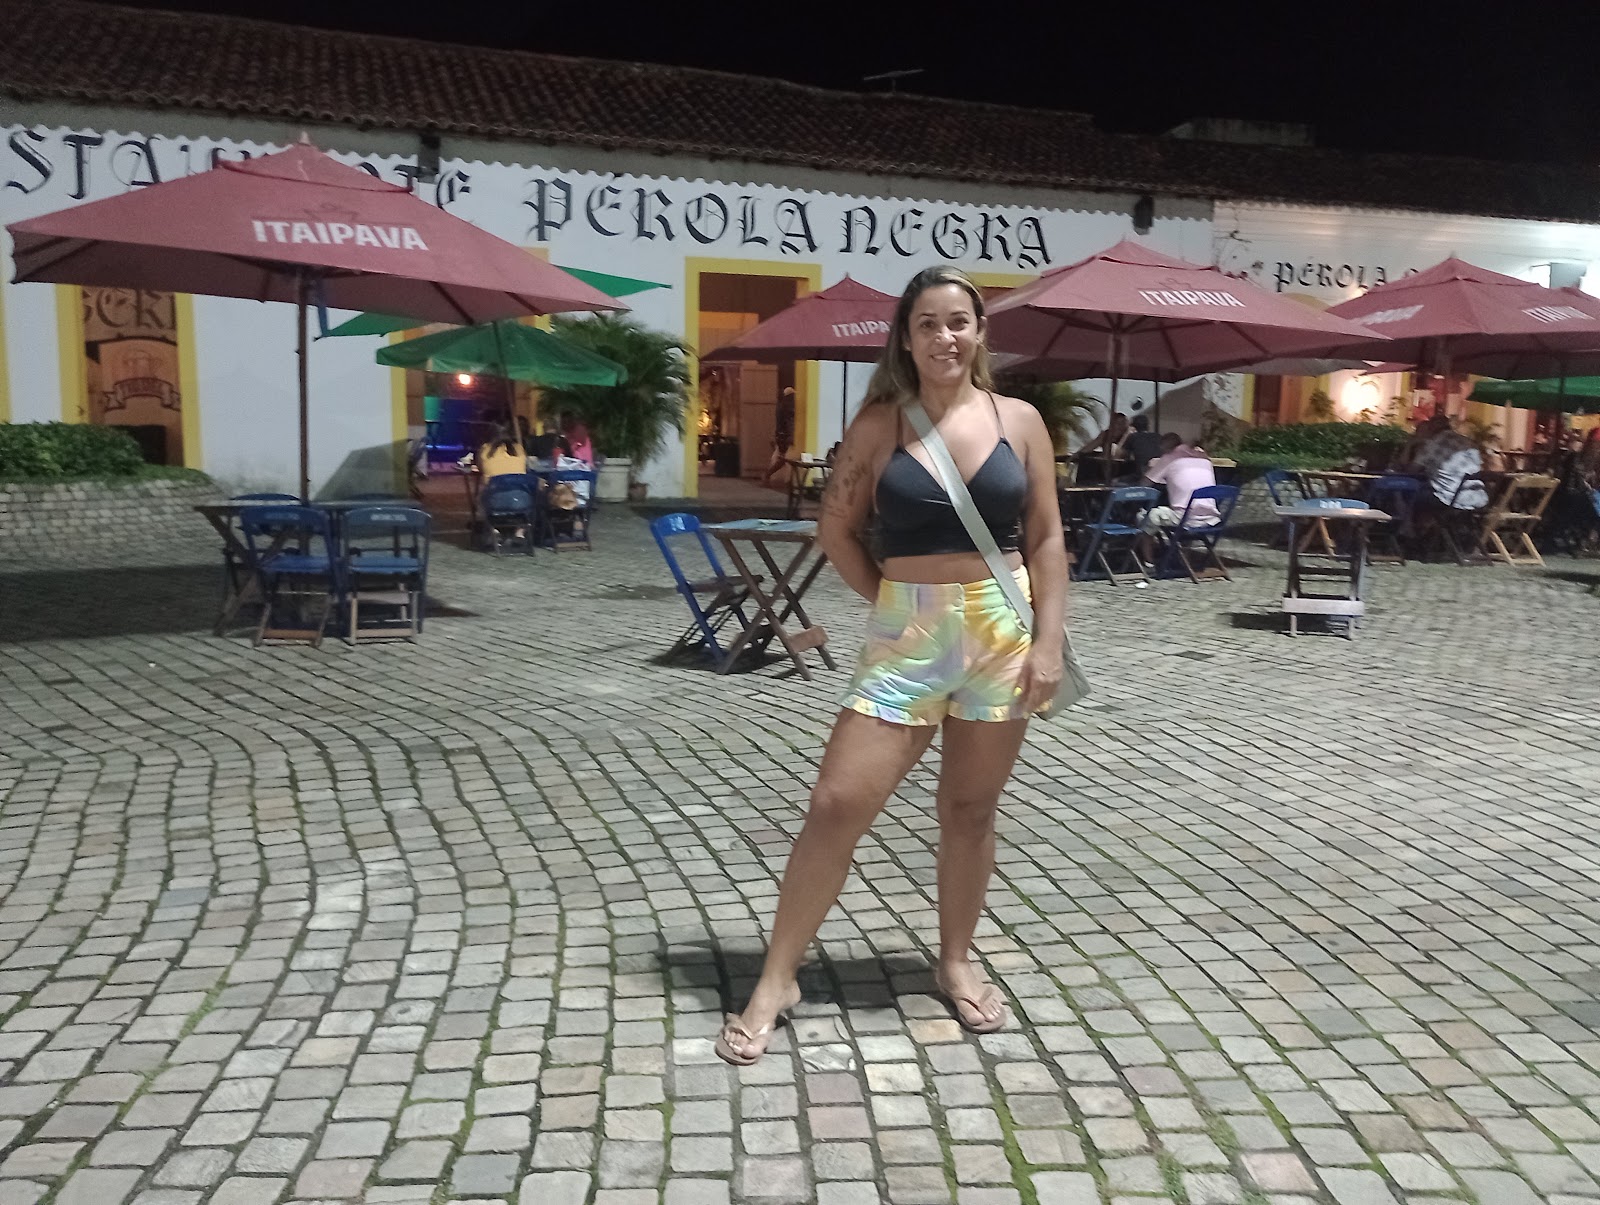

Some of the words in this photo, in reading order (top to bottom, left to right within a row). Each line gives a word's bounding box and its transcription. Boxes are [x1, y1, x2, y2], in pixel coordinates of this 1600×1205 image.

[251, 218, 430, 251] ITAIPAVA
[838, 205, 1052, 269] NEGRA
[1138, 290, 1247, 308] ITAIPAVA
[831, 320, 892, 338] ITAIPA
